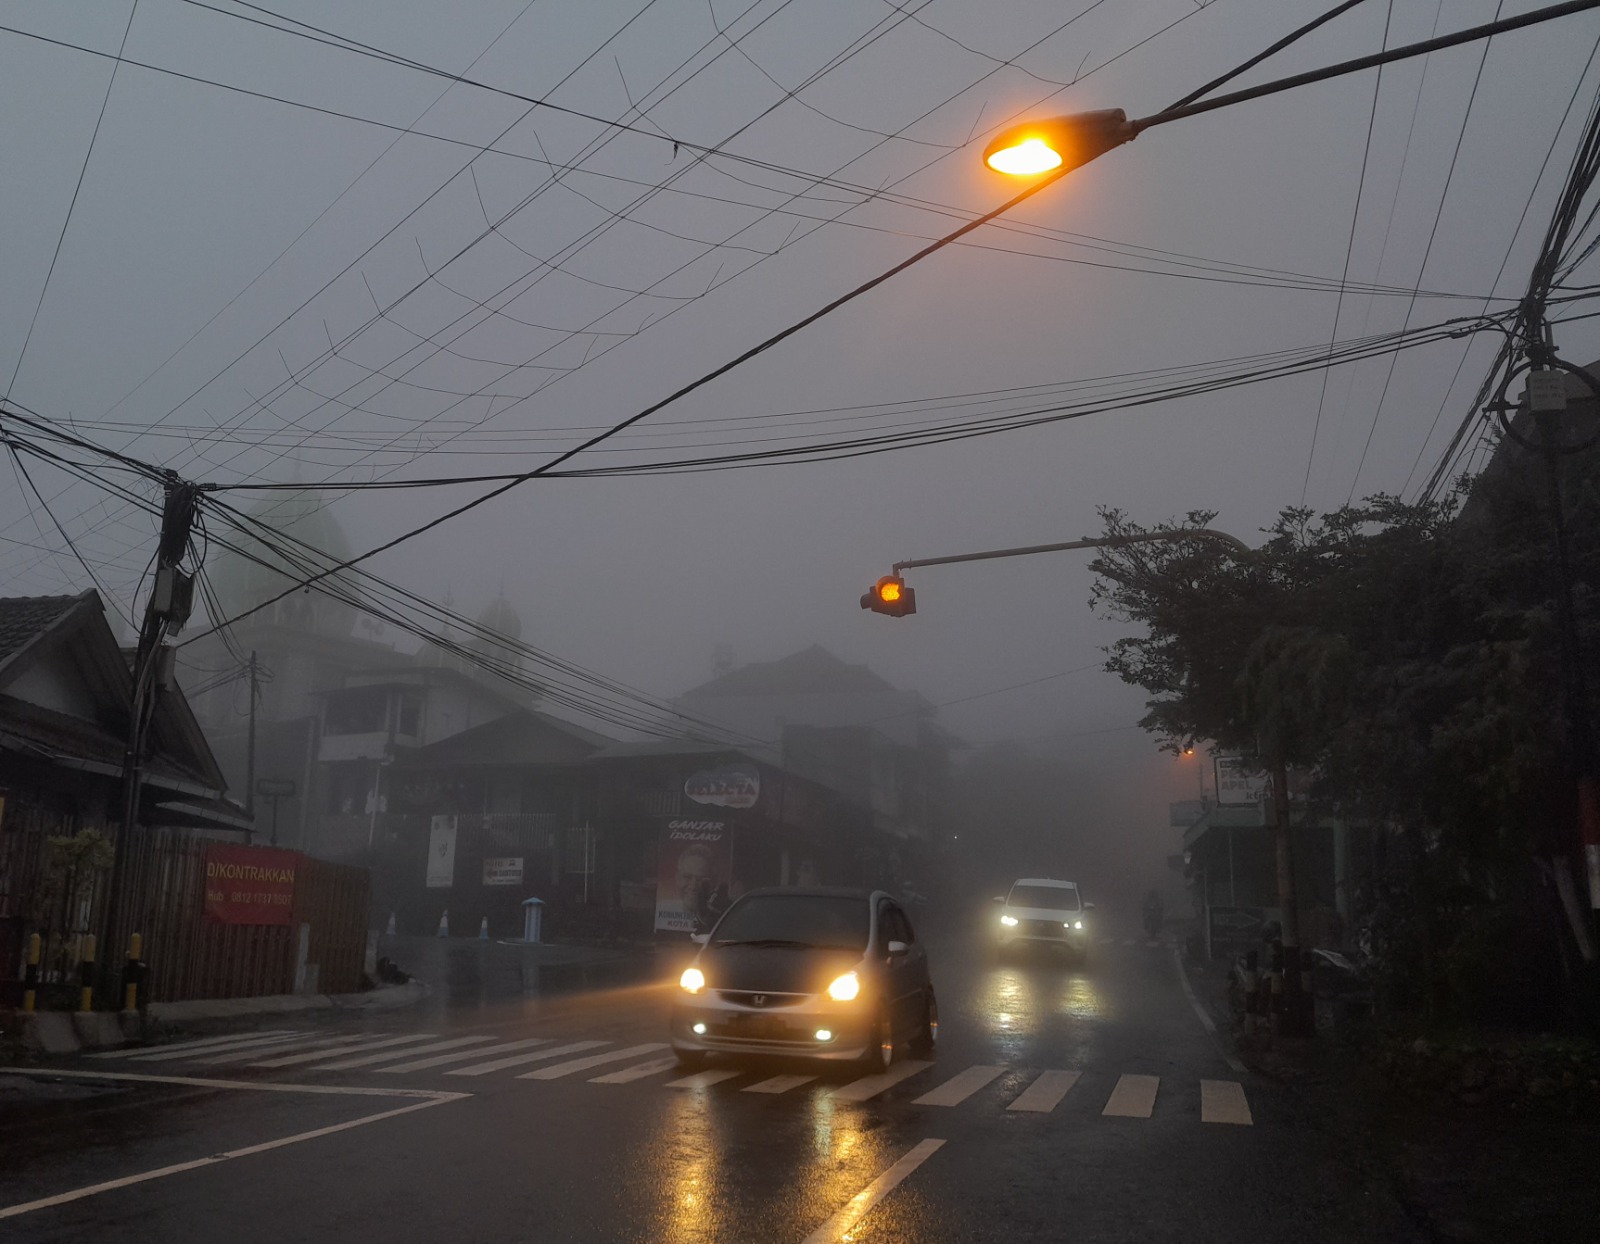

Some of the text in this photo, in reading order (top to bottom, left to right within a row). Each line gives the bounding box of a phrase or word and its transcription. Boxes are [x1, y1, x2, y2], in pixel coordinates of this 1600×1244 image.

[668, 820, 725, 831] GANJAR
[207, 862, 295, 883] DIKONTRAKKAN
[668, 919, 689, 929] KOTA
